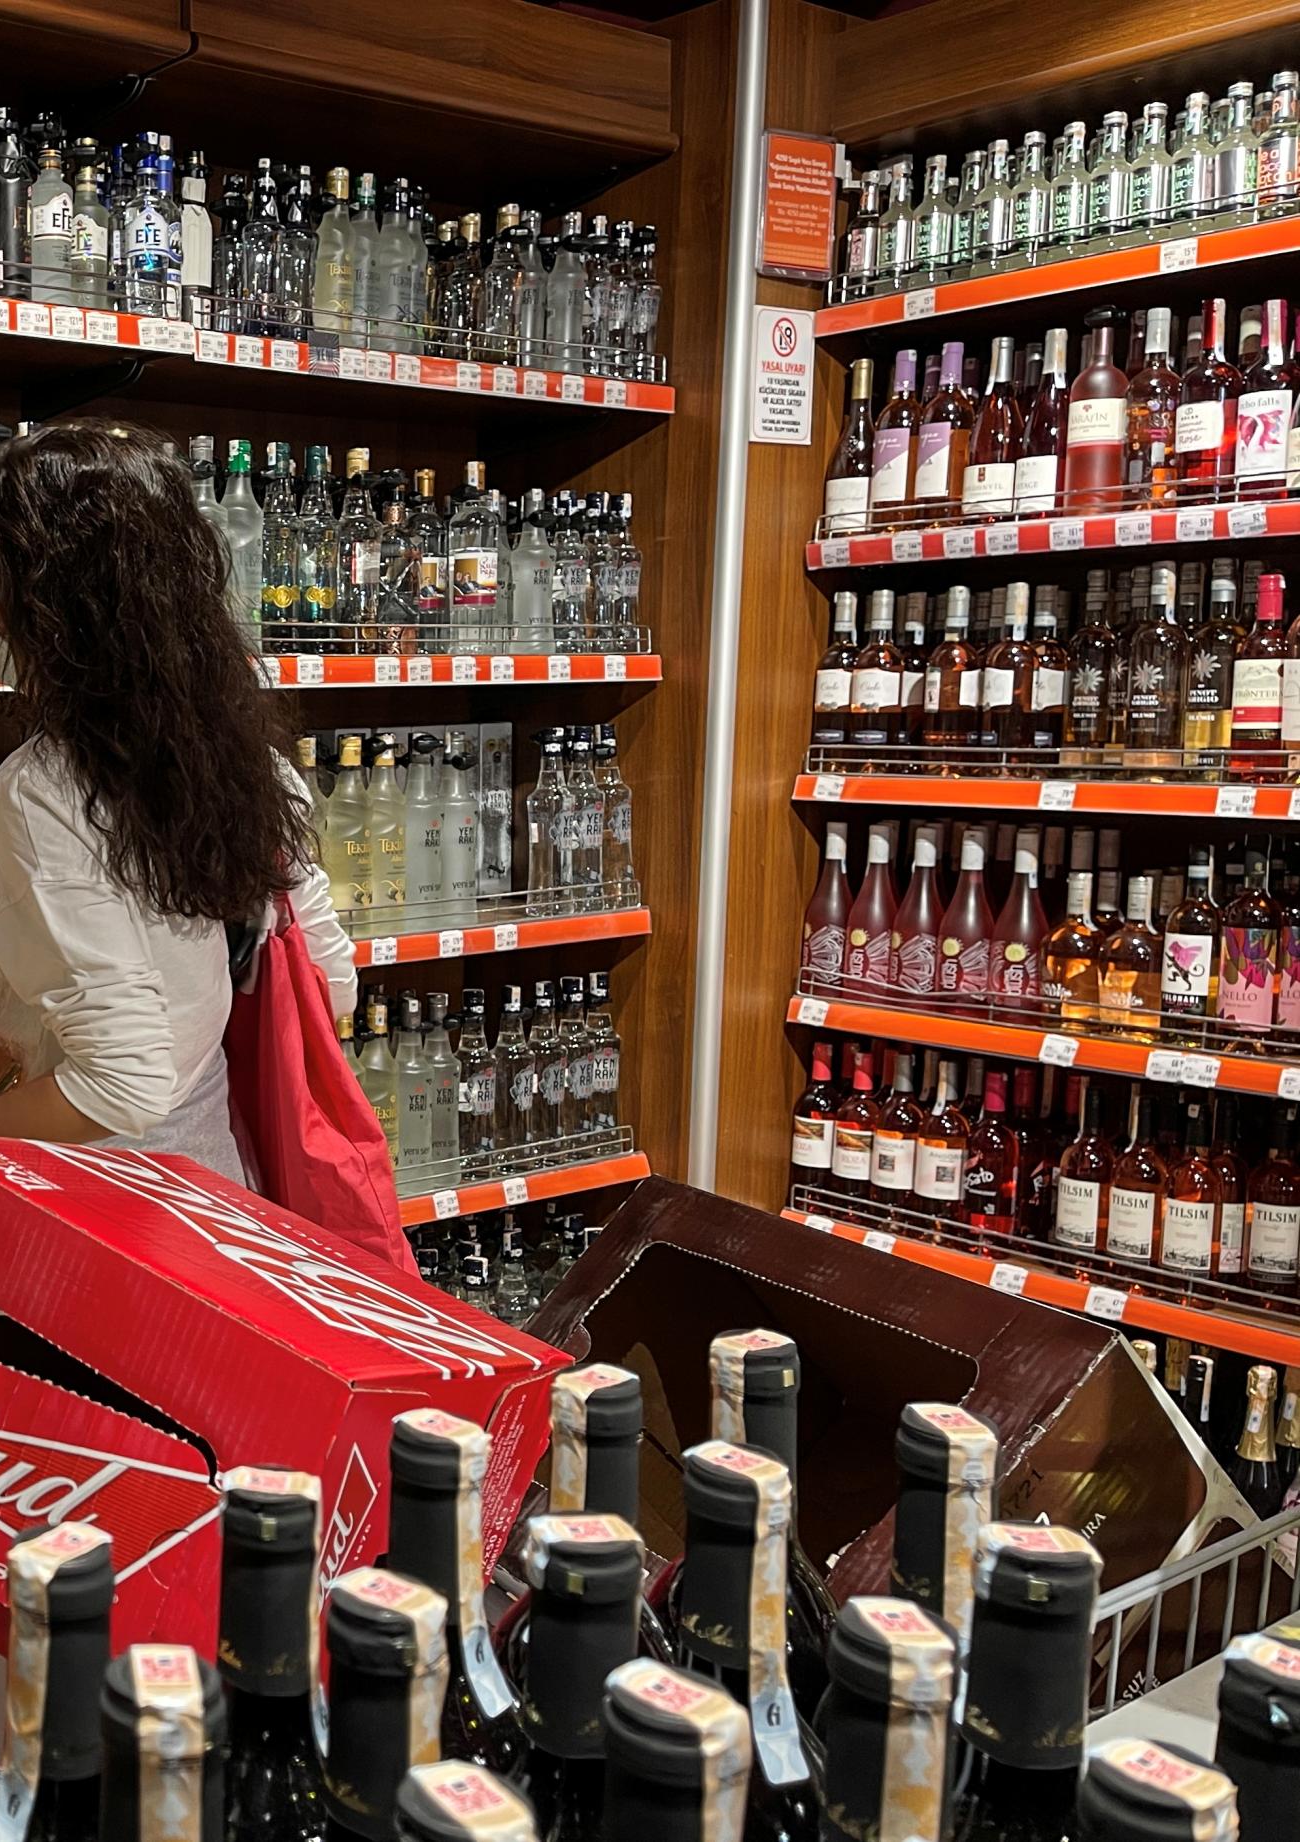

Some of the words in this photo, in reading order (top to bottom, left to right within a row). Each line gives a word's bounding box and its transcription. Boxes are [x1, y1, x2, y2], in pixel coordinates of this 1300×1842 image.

[135, 222, 161, 245] EFE
[762, 361, 783, 372] YASAL
[785, 363, 806, 374] UYARI
[1059, 1181, 1094, 1198] TILSIM
[1112, 1194, 1149, 1209] TILSIM
[1169, 1205, 1209, 1220] TILSIM
[1255, 1208, 1298, 1224] TILSIM
